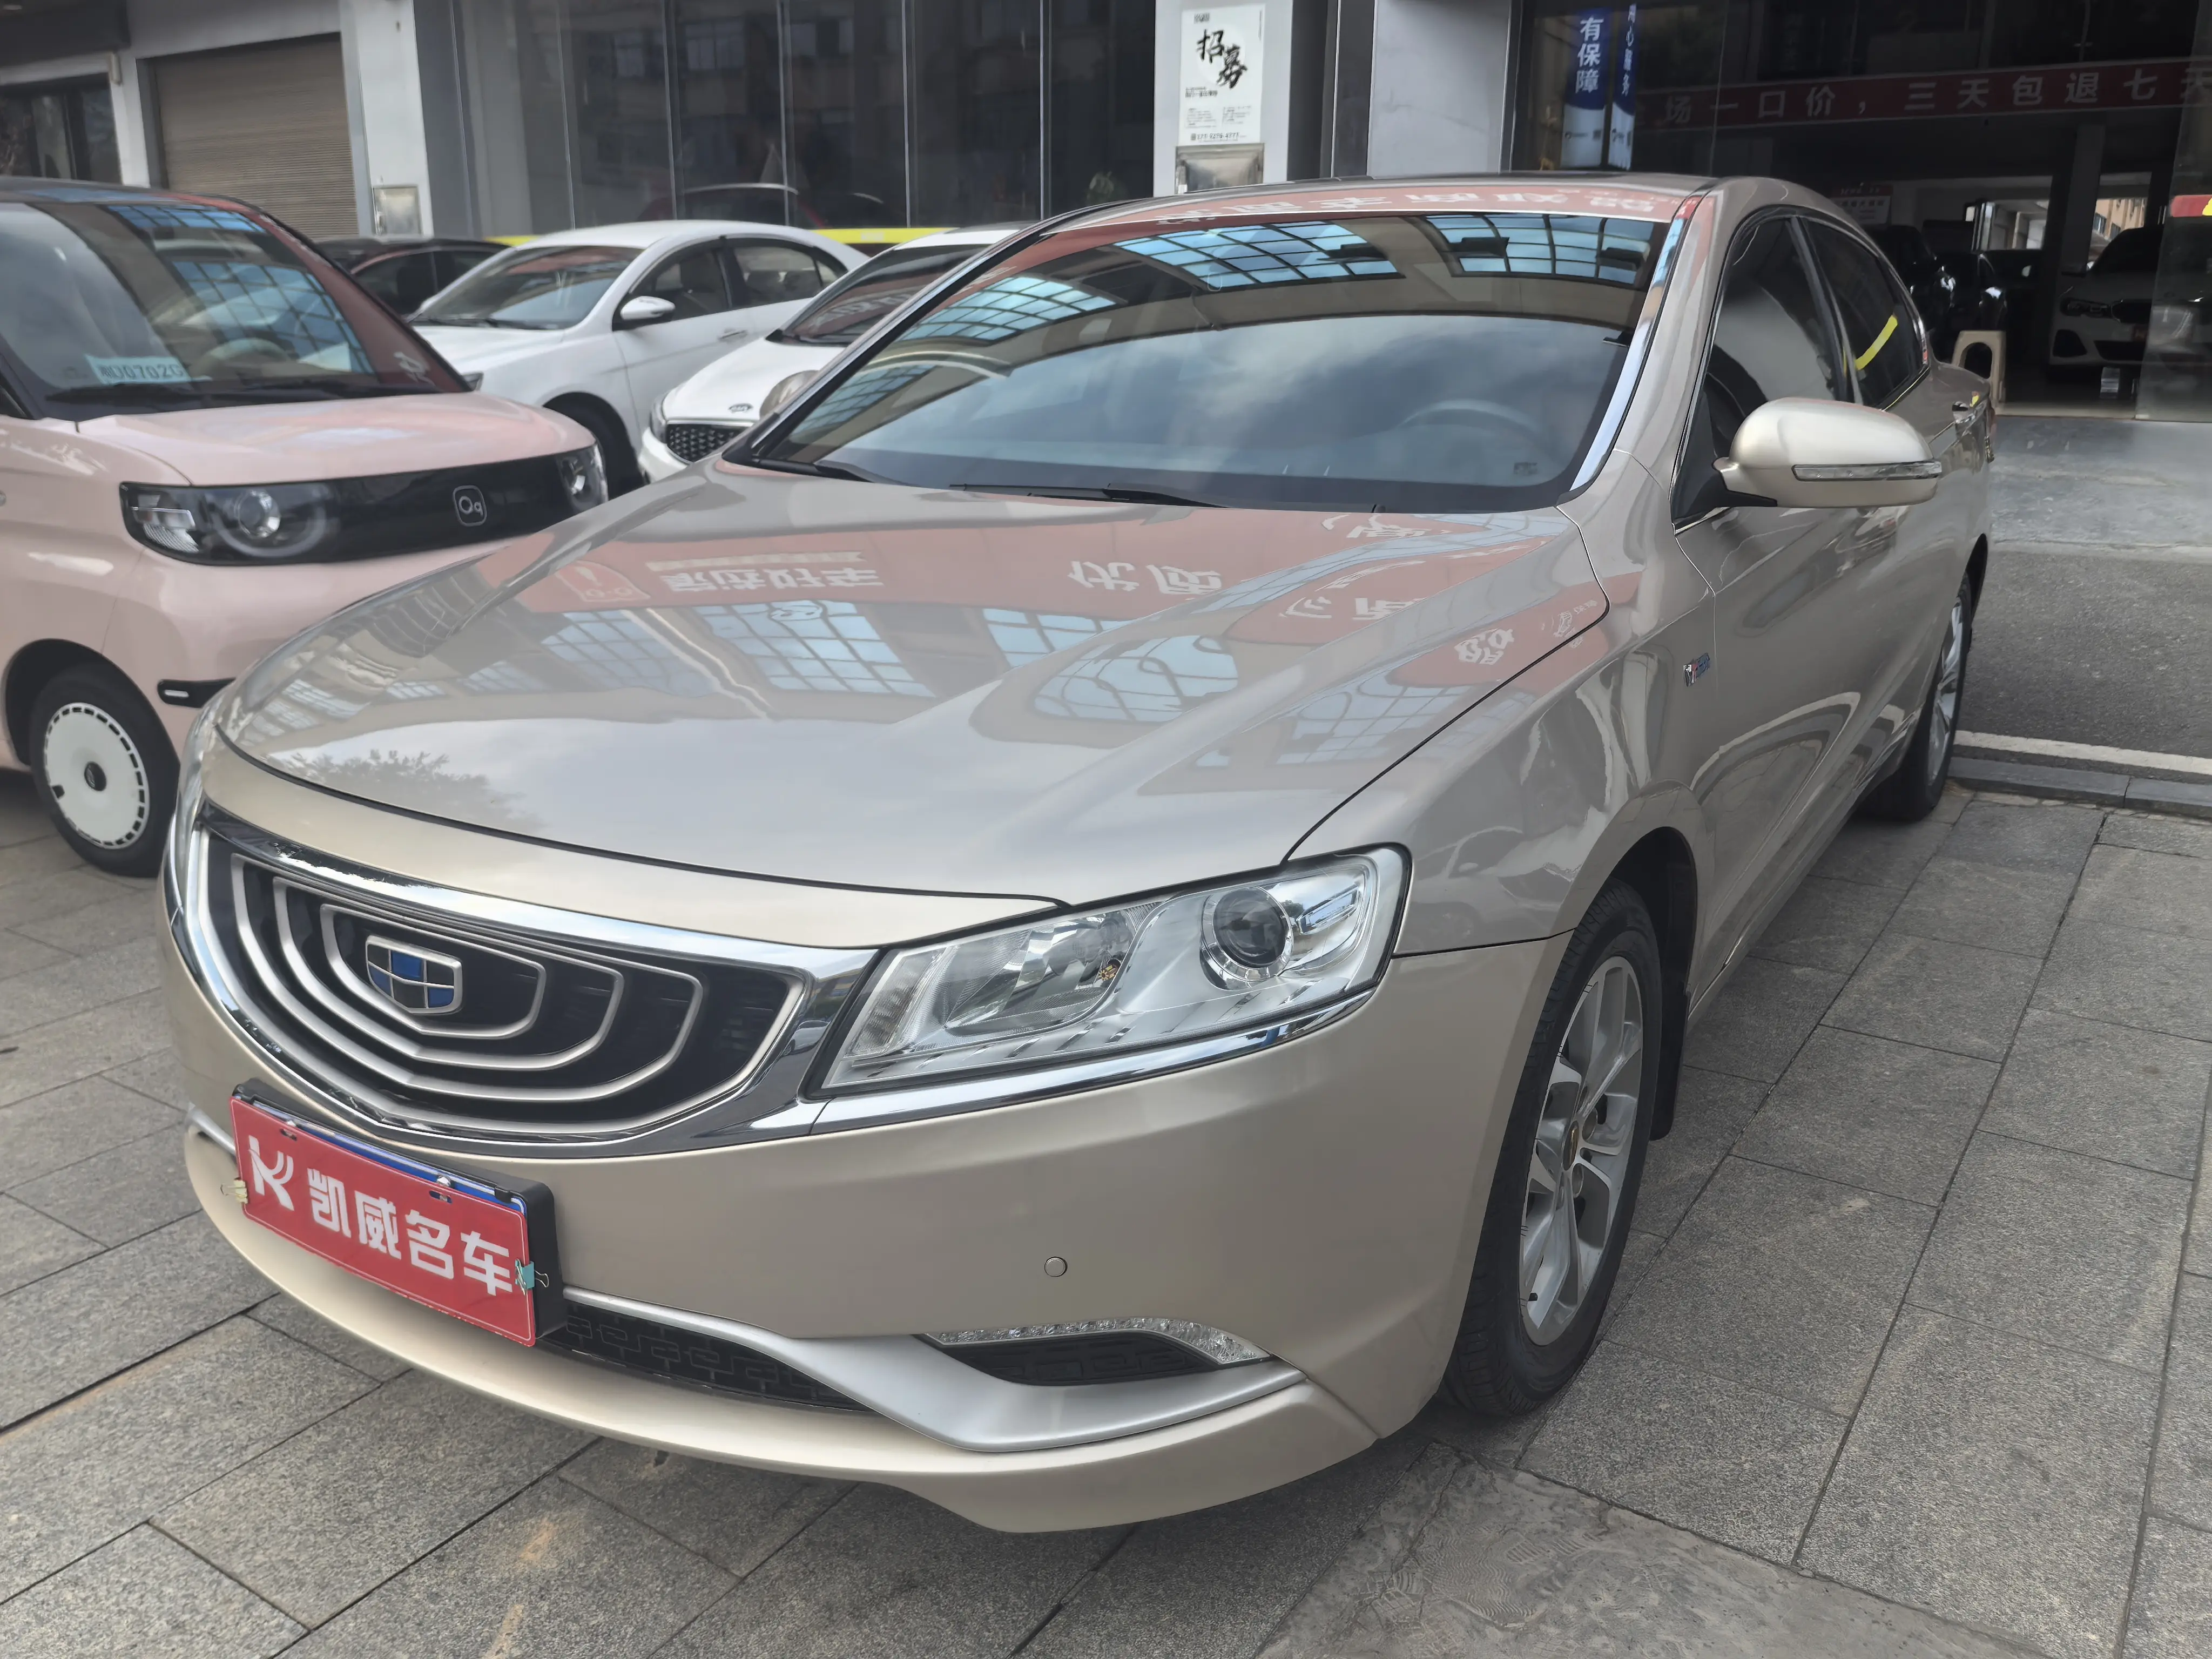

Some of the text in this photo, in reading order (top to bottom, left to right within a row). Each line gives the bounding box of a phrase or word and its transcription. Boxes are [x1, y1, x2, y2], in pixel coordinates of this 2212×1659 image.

[1195, 29, 1247, 89] 招募
[1575, 15, 1604, 94] 有保障
[306, 1167, 512, 1297] 凯威名车
